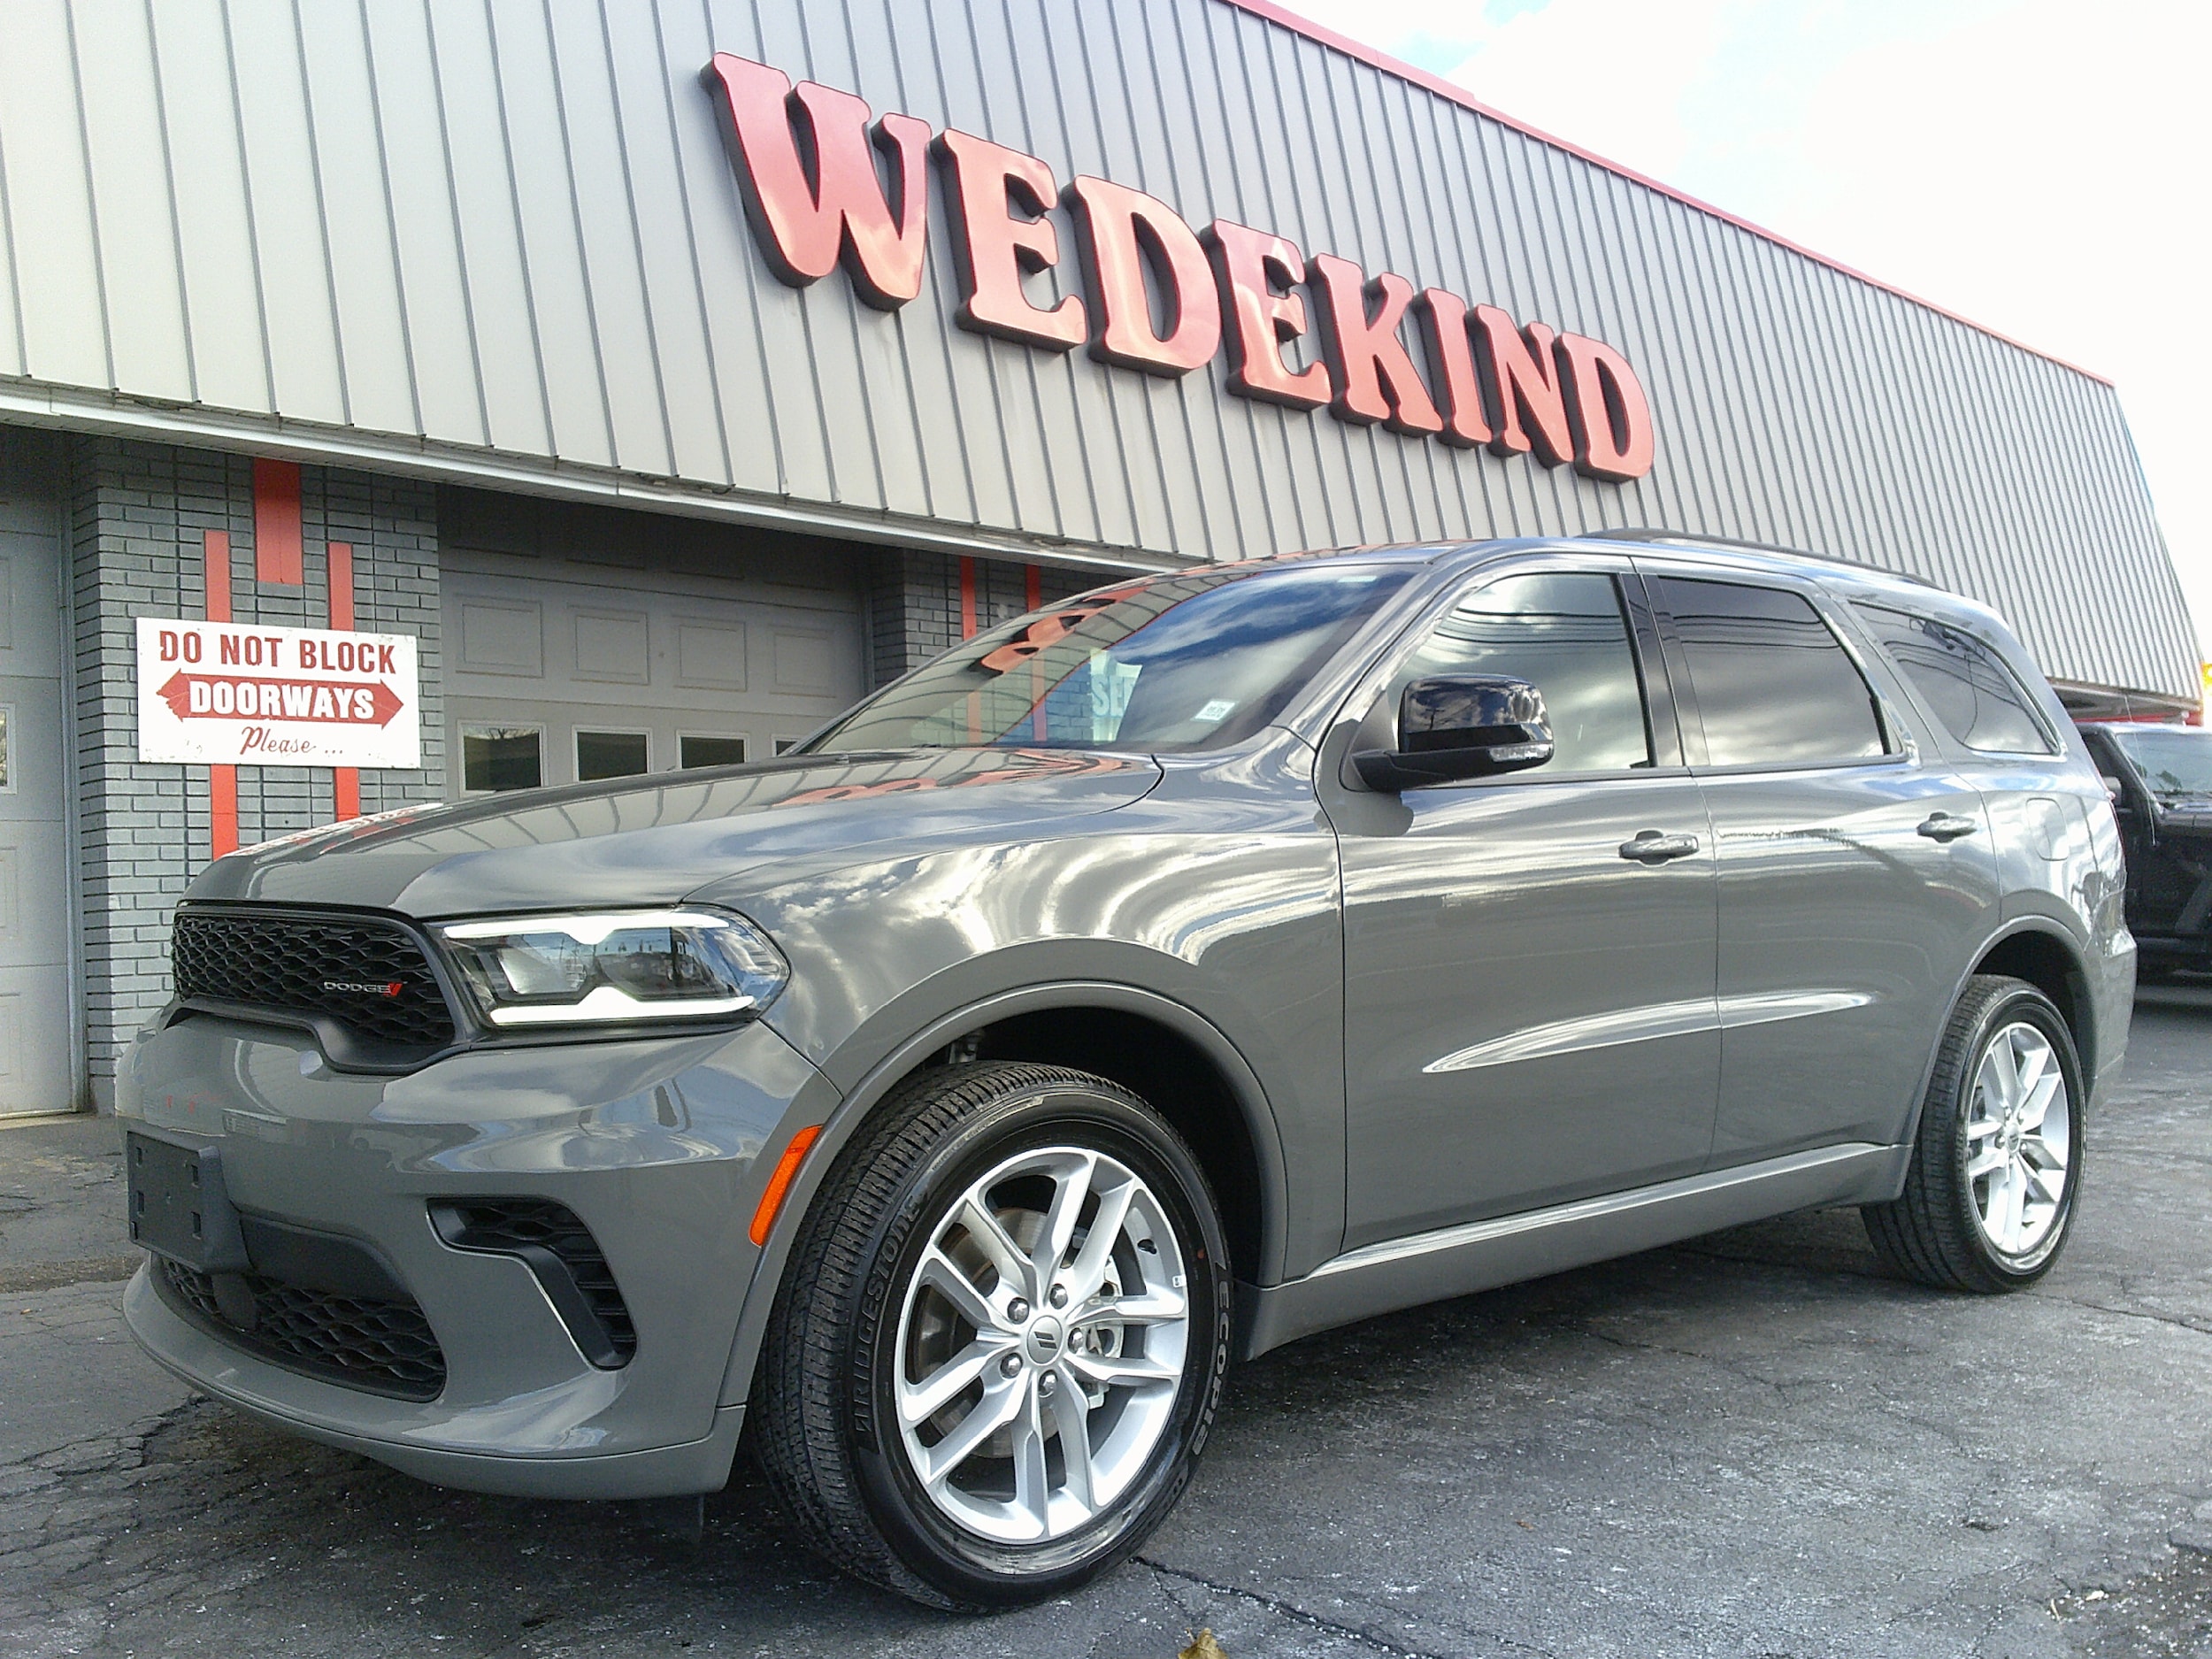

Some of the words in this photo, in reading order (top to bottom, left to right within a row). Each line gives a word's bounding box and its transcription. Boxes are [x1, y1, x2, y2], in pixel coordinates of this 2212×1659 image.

[703, 51, 1654, 482] WEDEKIND
[159, 630, 202, 664] DO
[220, 634, 283, 667] NOT
[299, 639, 396, 674] BLOCK
[188, 680, 375, 720] DOORWAYS
[323, 981, 392, 994] DODGE
